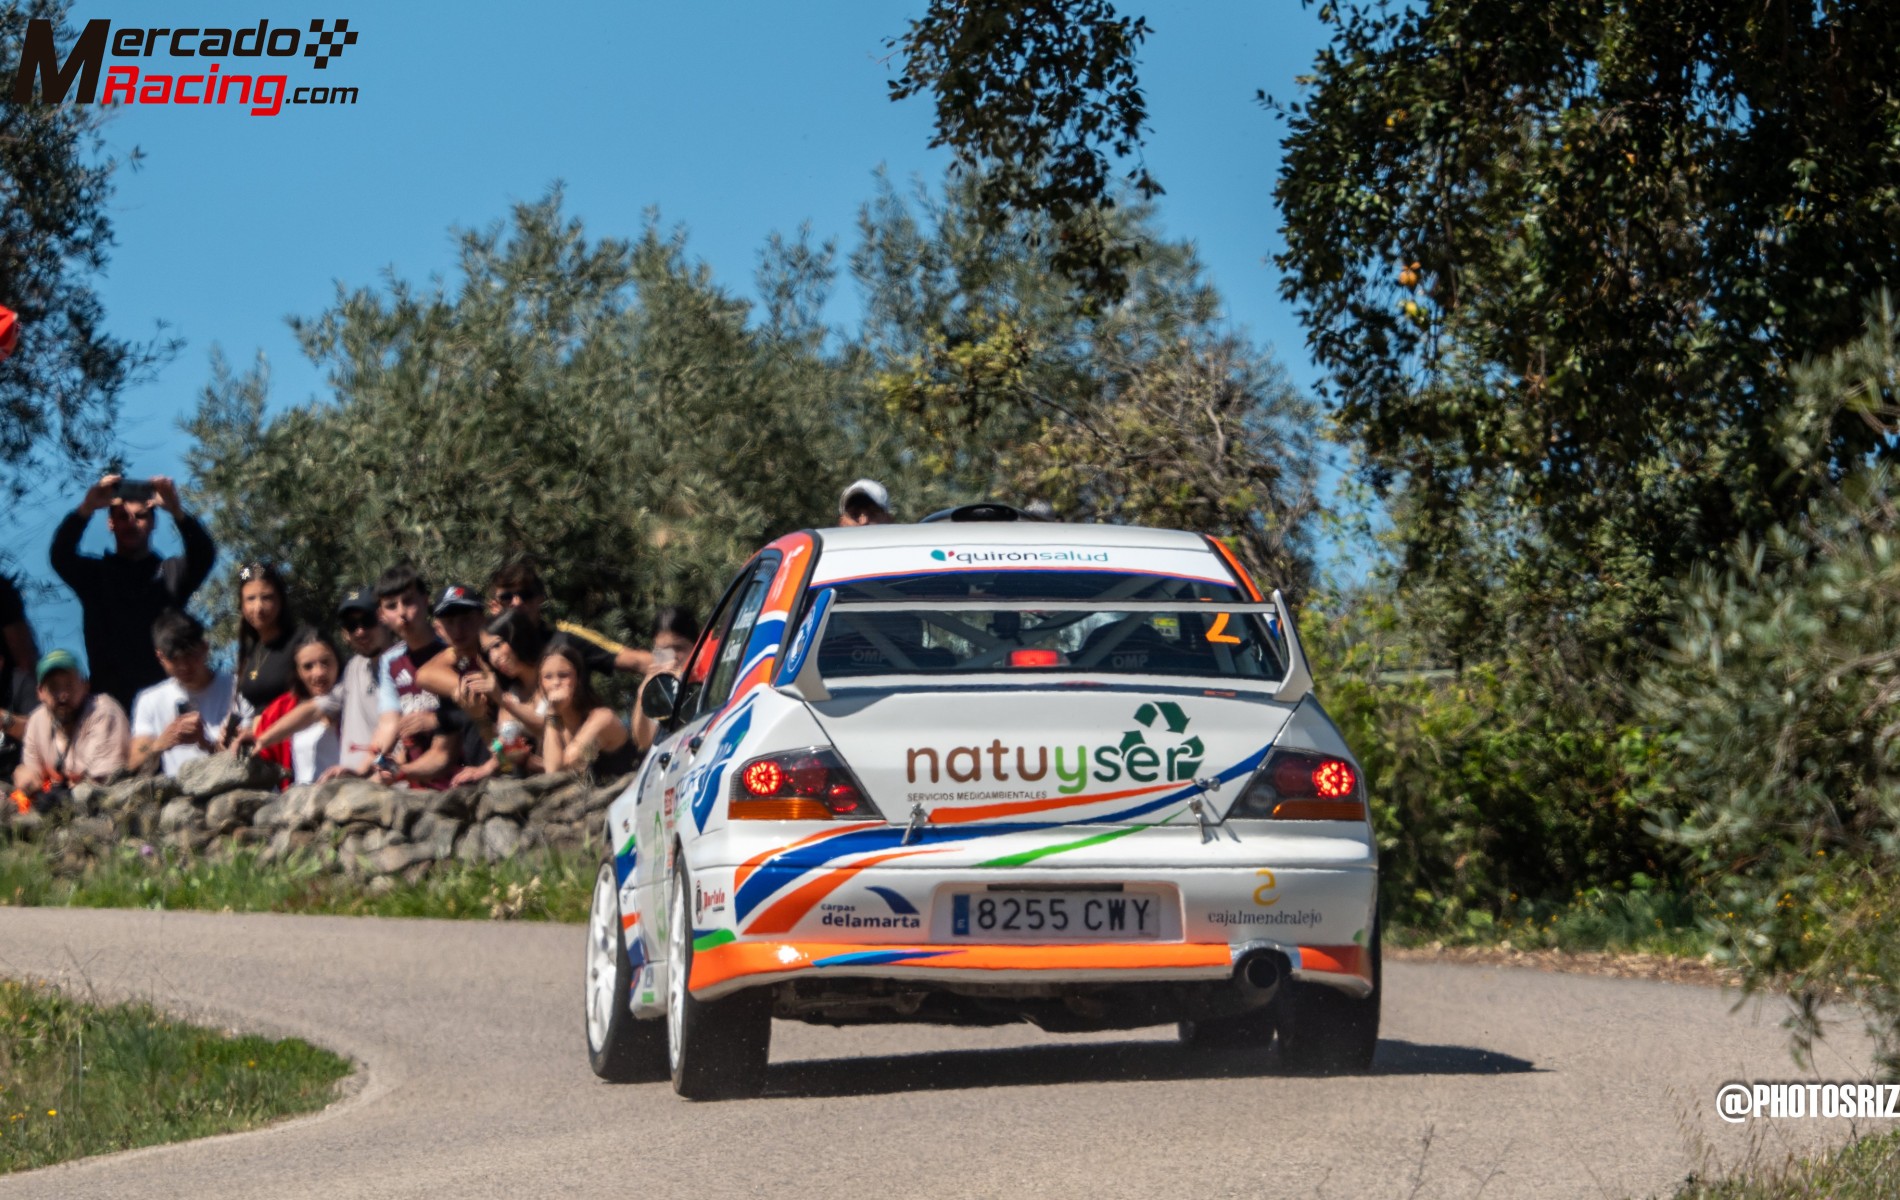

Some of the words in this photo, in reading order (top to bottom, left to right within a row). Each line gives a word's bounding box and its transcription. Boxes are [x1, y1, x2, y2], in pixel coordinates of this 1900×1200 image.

[1112, 655, 1149, 668] OMP
[906, 738, 1195, 794] natuyser
[907, 792, 955, 802] SERVICIOS
[956, 790, 1048, 801] MEDIOAMBIENTALES
[820, 903, 856, 912] carpas
[977, 898, 1069, 931] 8255
[1084, 898, 1150, 931] CWY
[822, 912, 921, 929] delamarta
[1208, 908, 1323, 928] cajalmendralejo
